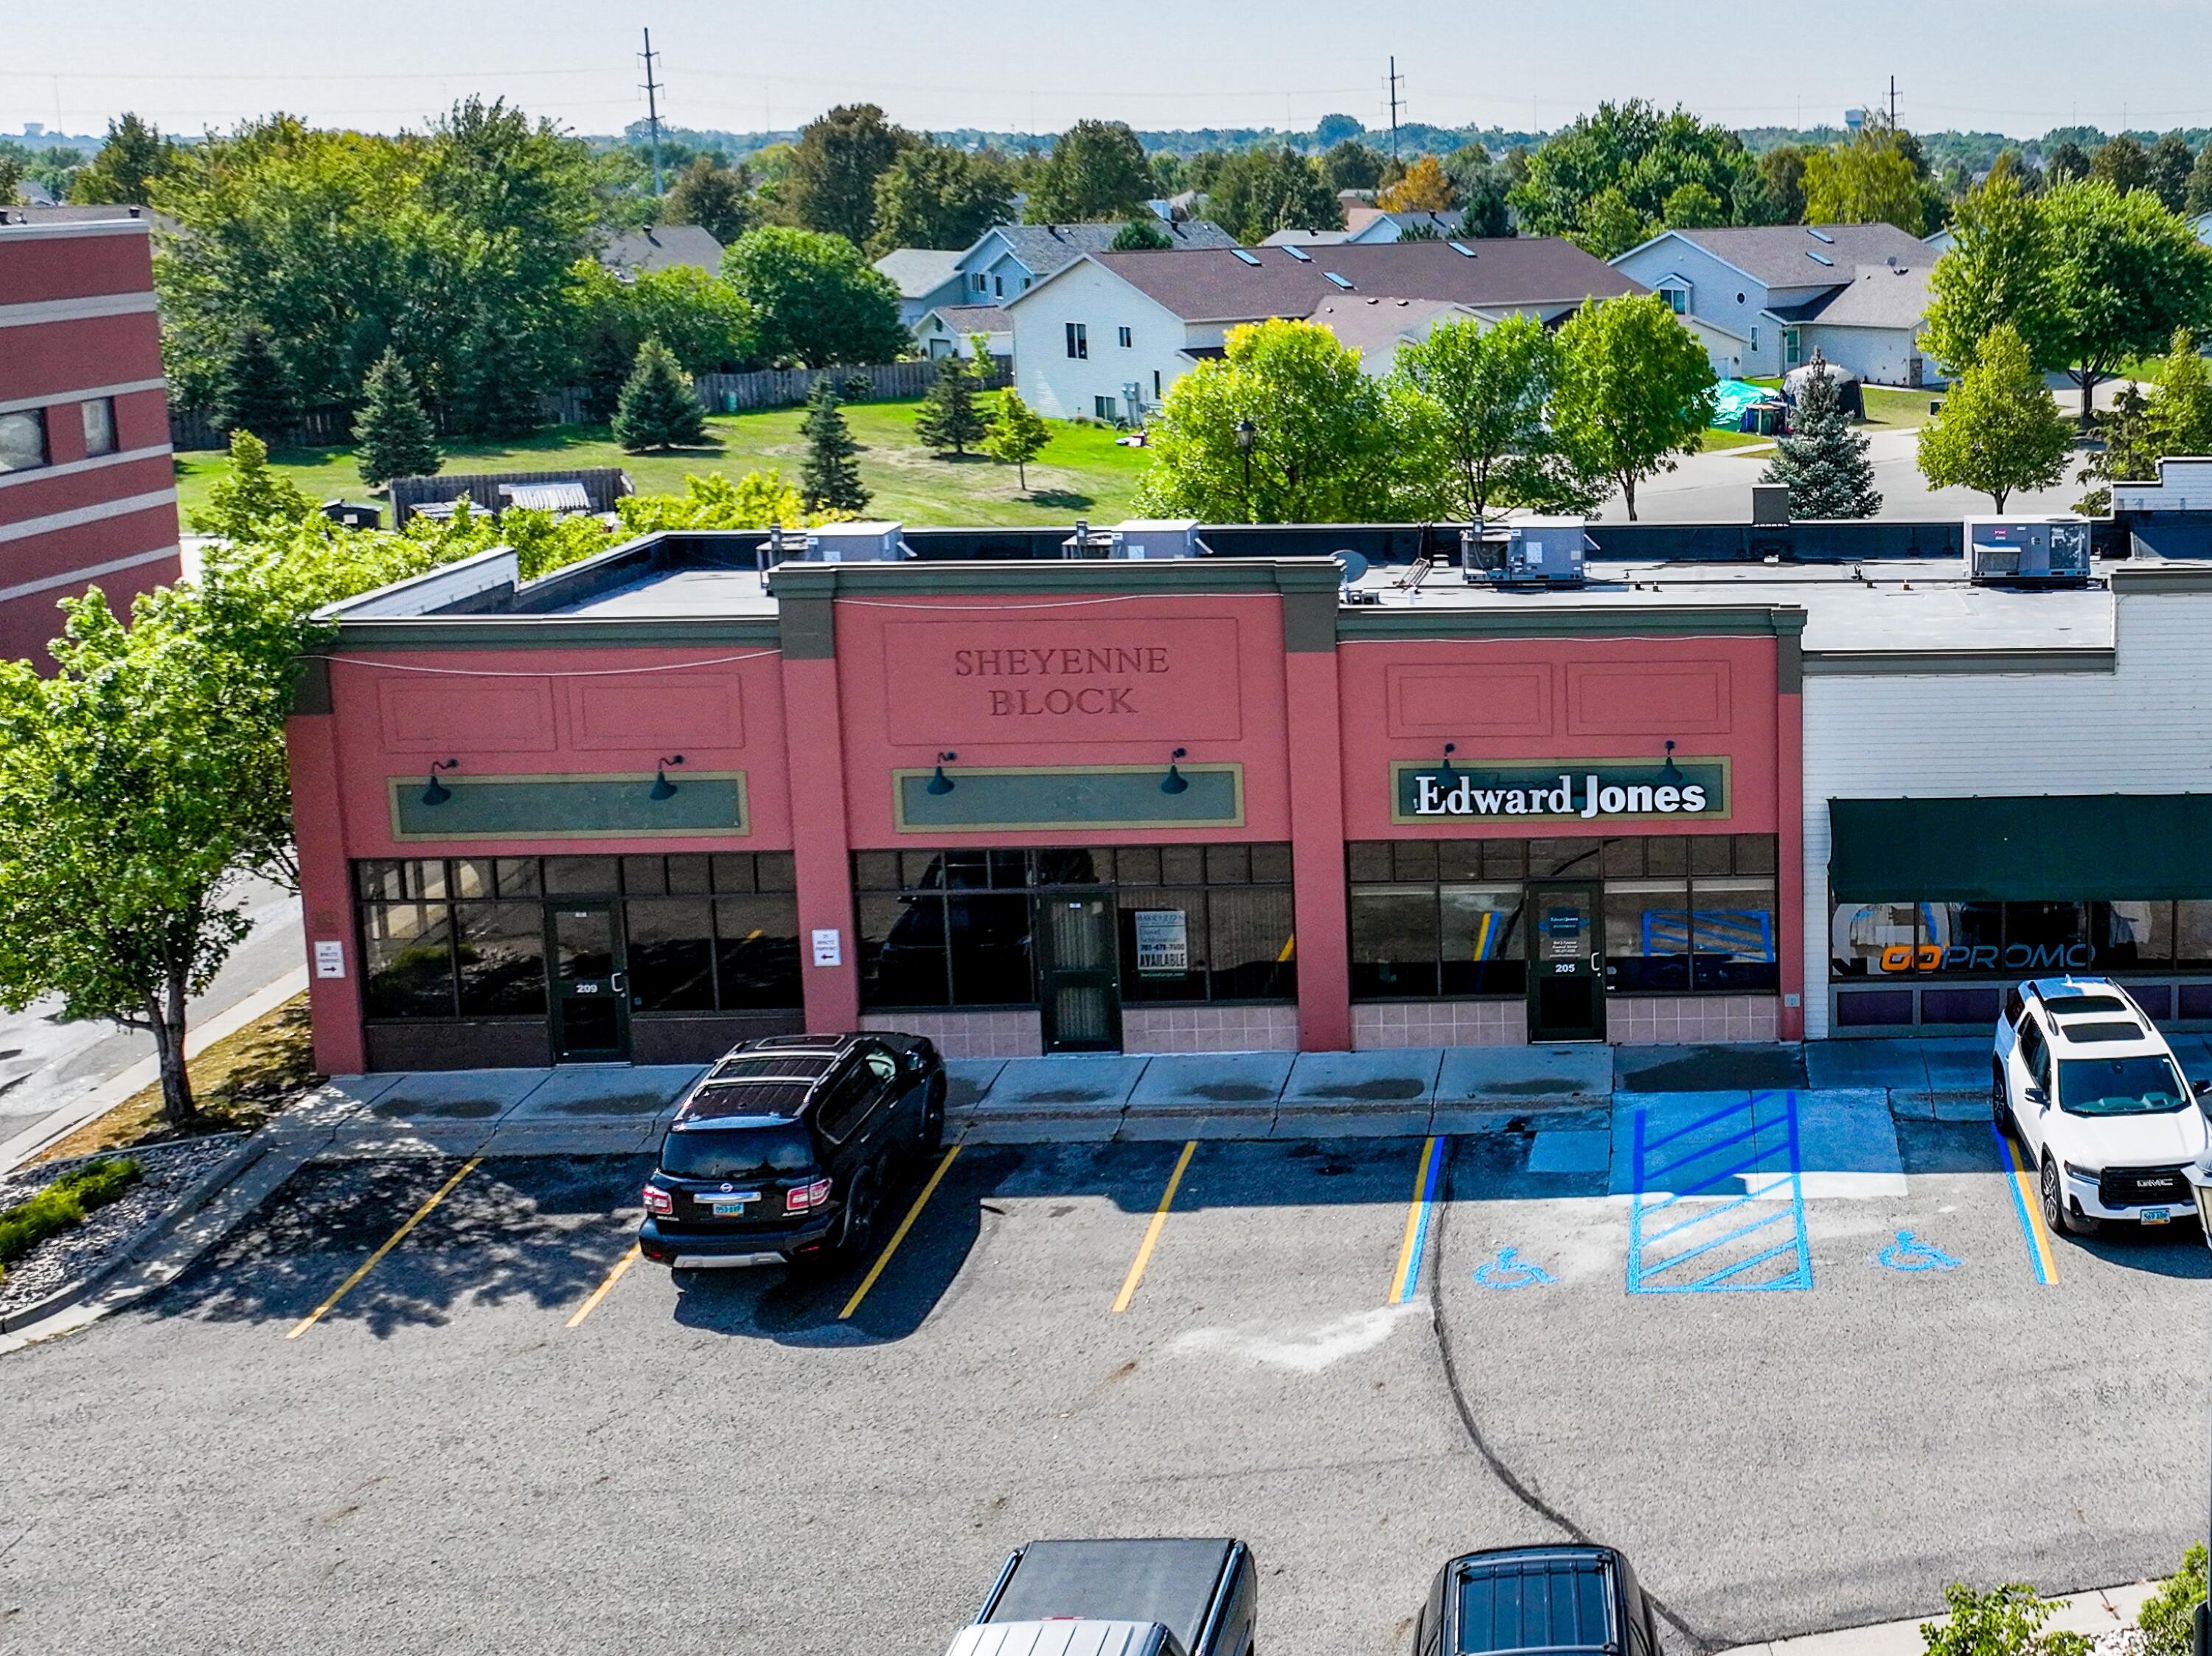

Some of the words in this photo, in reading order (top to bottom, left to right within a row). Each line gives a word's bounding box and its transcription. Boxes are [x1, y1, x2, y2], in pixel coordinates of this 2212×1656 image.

[955, 647, 1169, 676] SHEYENNE
[989, 687, 1138, 716] BLOCK
[1416, 775, 1574, 814] Edward
[1581, 774, 1706, 818] Jones
[1140, 953, 1185, 967] AVAILABLE
[1555, 964, 1575, 973] 205
[576, 984, 598, 993] 209
[2136, 1178, 2174, 1187] GMC
